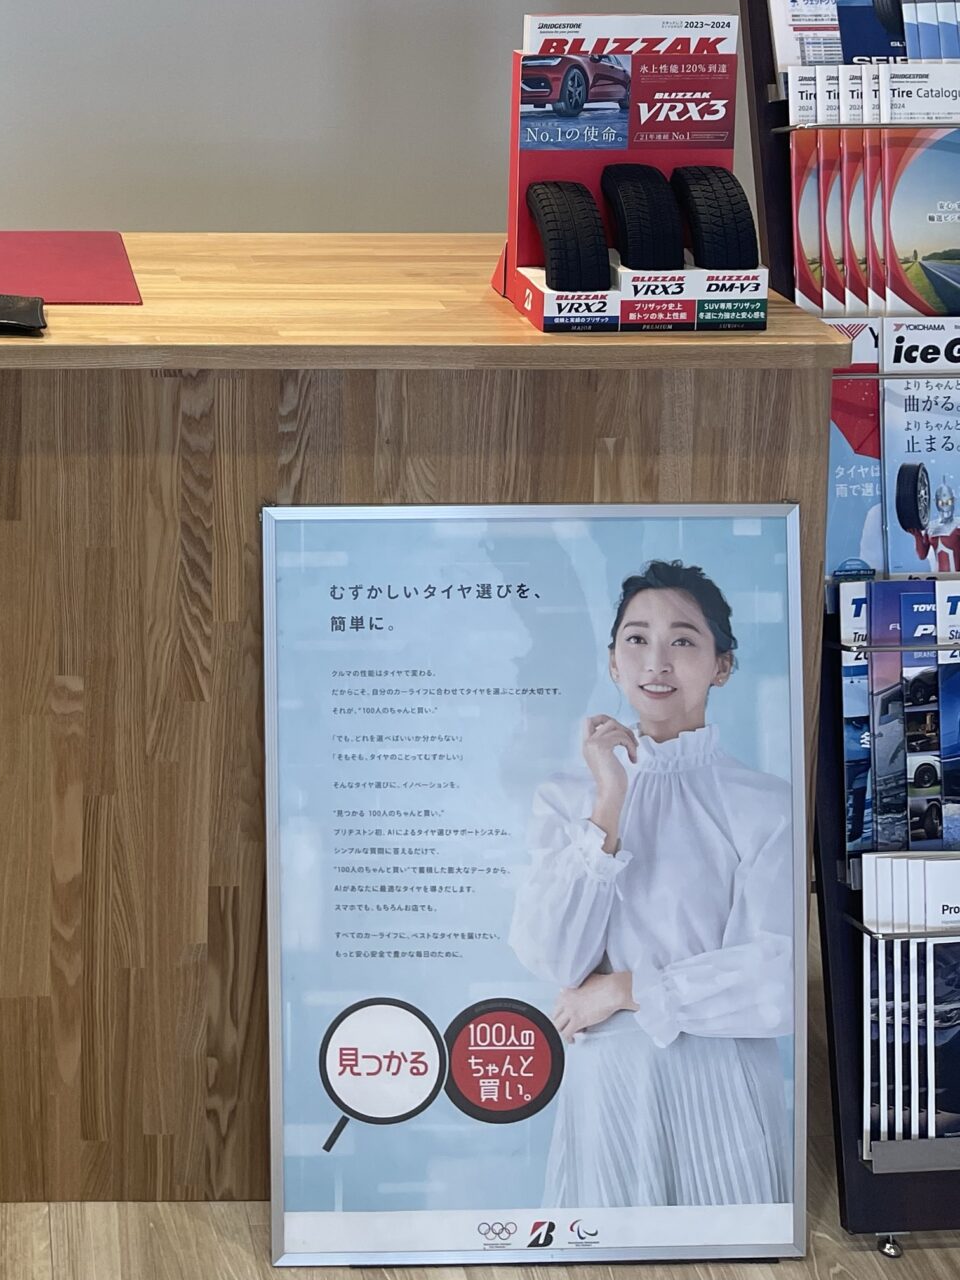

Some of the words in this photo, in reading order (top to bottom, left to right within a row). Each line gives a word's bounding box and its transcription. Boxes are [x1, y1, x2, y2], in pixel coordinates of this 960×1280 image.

[538, 22, 582, 30] BRIDGESTONE
[538, 37, 728, 55] BLIZZAK
[653, 91, 712, 99] BLIZZAK
[890, 87, 913, 98] Tire
[637, 100, 729, 124] VRX3
[525, 125, 623, 143] No.1の使命。
[632, 283, 685, 297] VRX3
[706, 282, 761, 293] DM-V3
[556, 301, 608, 315] VRX2
[635, 303, 682, 311] ブリザック史上
[904, 380, 921, 391] より
[904, 421, 920, 431] より
[330, 583, 542, 600] むずかしいタイヤ選びを、
[330, 616, 394, 632] 簡単に。
[913, 624, 936, 637] P
[468, 1023, 535, 1047] 100人の
[338, 1047, 429, 1077] 見つかる
[468, 1055, 534, 1077] ちゃんと
[479, 1079, 532, 1102] 買い。
